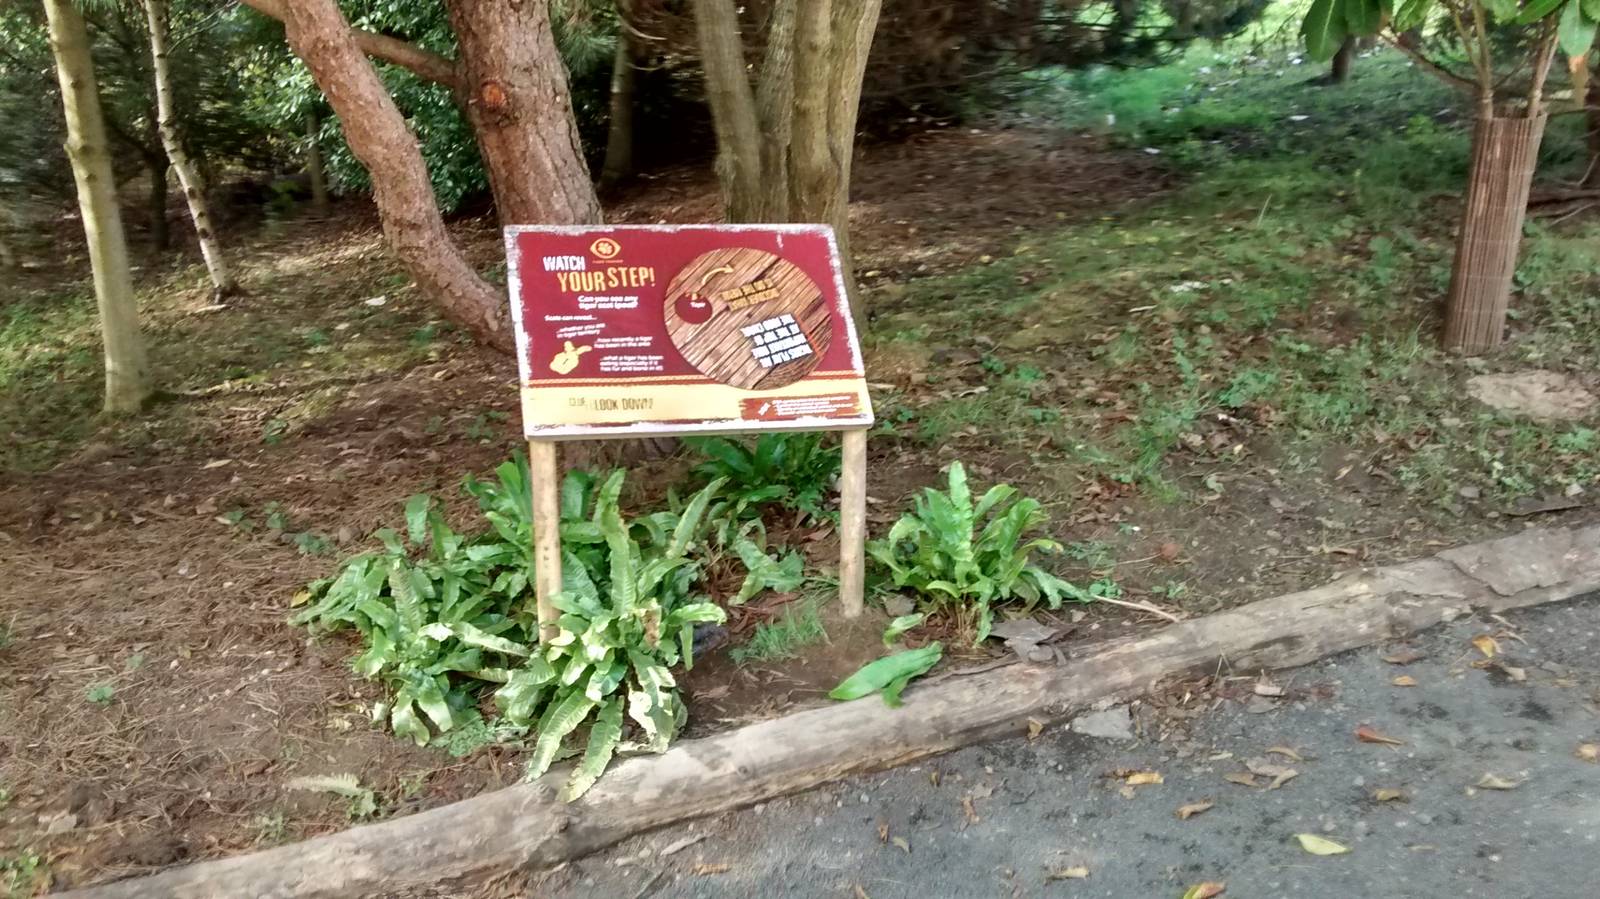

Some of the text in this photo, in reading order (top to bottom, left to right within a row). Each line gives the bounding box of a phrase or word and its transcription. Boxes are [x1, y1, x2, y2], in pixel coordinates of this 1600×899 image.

[542, 255, 586, 271] WATCH
[557, 266, 656, 293] YOUR STEP!
[594, 397, 619, 411] LOOK
